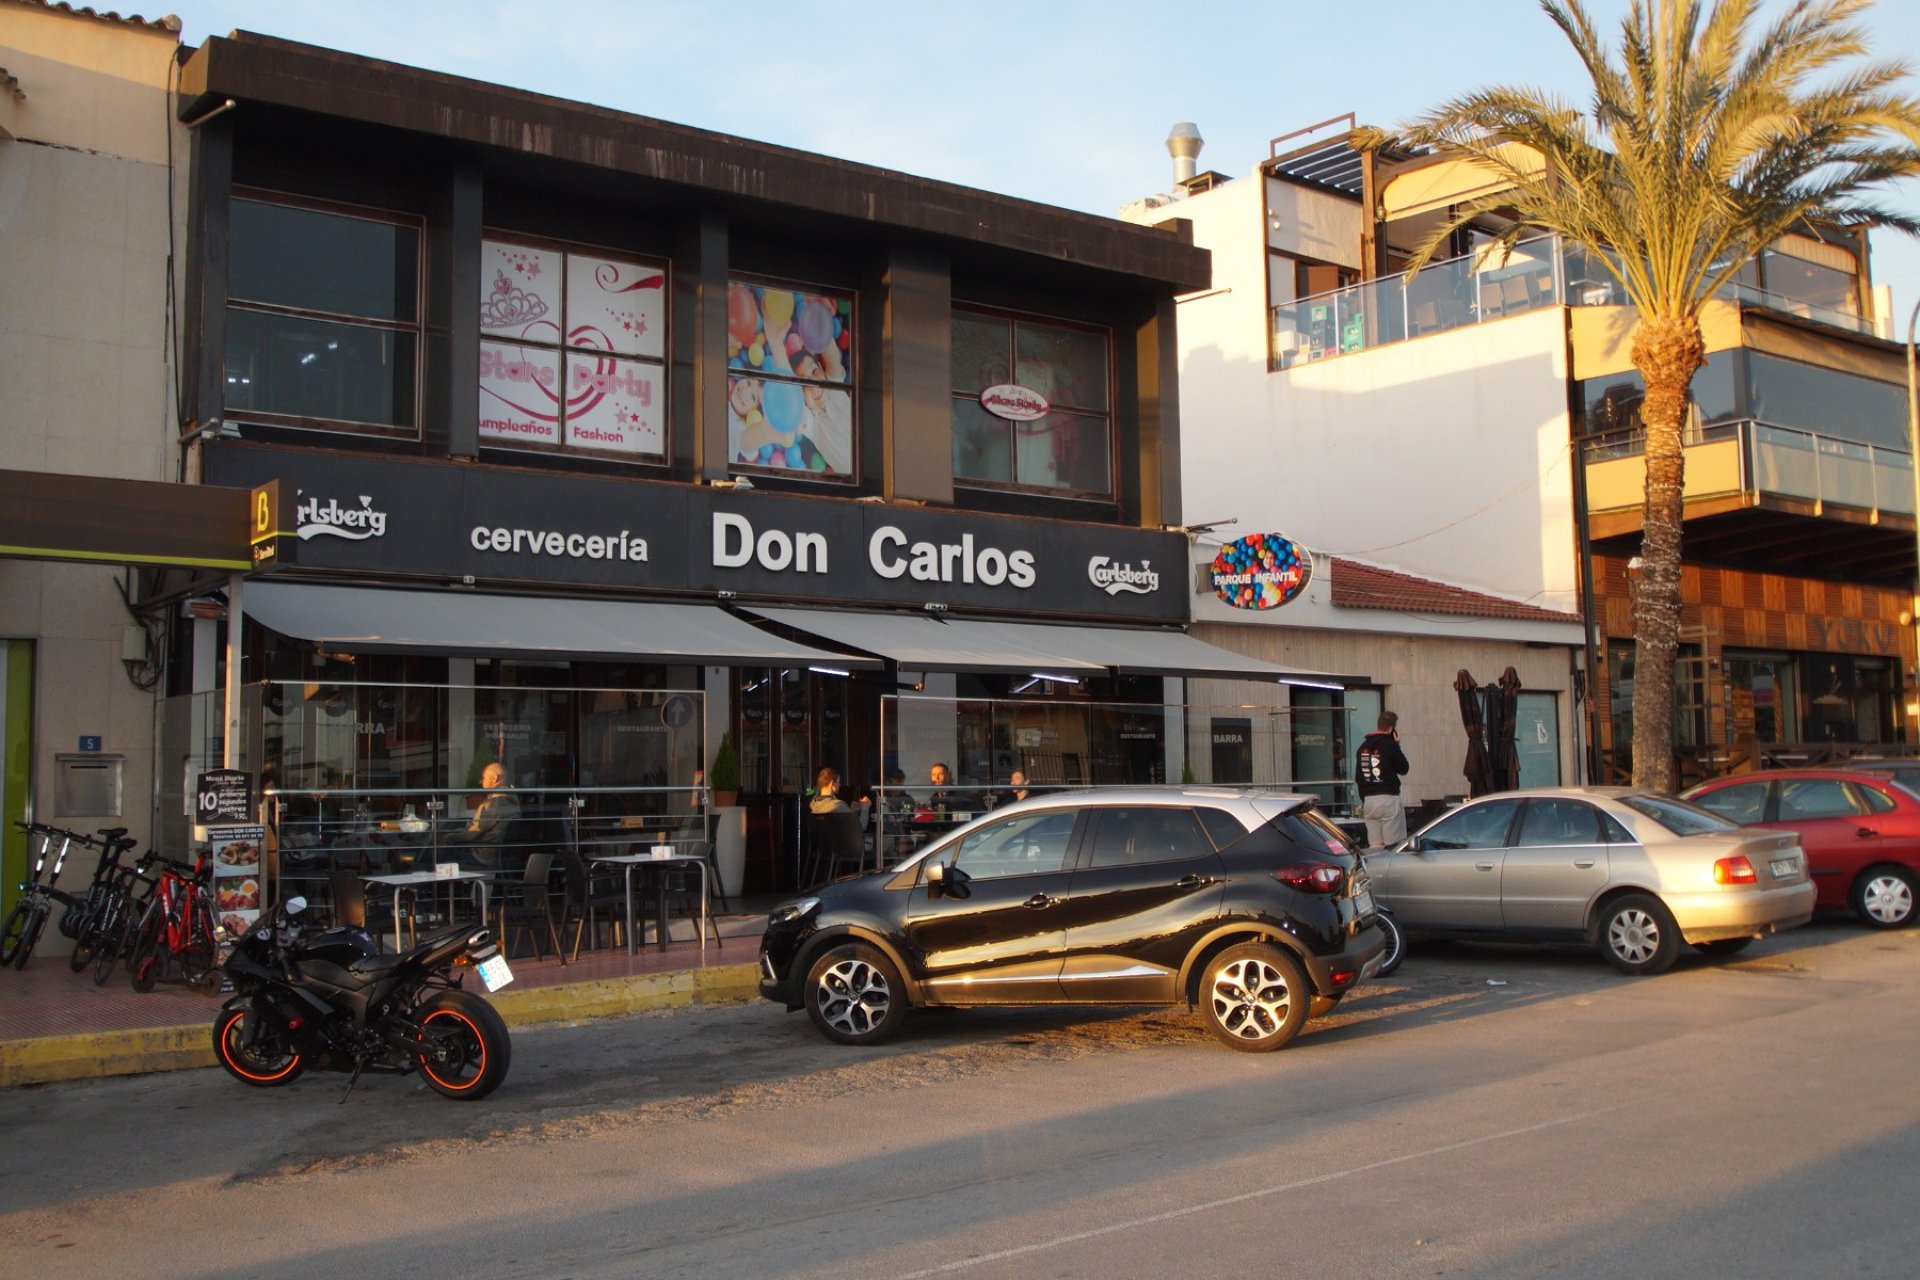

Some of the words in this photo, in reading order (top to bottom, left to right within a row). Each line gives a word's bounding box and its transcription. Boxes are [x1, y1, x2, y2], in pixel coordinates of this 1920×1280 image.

[478, 417, 553, 436] umpleaños
[573, 425, 624, 443] Fashion
[297, 490, 387, 538] rlsberg
[470, 526, 648, 562] cervecería
[712, 511, 828, 574] Don
[868, 525, 1037, 589] Carlos
[1088, 555, 1159, 592] Carlsberg
[1214, 574, 1252, 586] PARQUE
[1255, 571, 1299, 582] INFANTIL
[87, 738, 94, 749] 5
[1213, 734, 1244, 743] BARRA
[198, 791, 218, 810] 10
